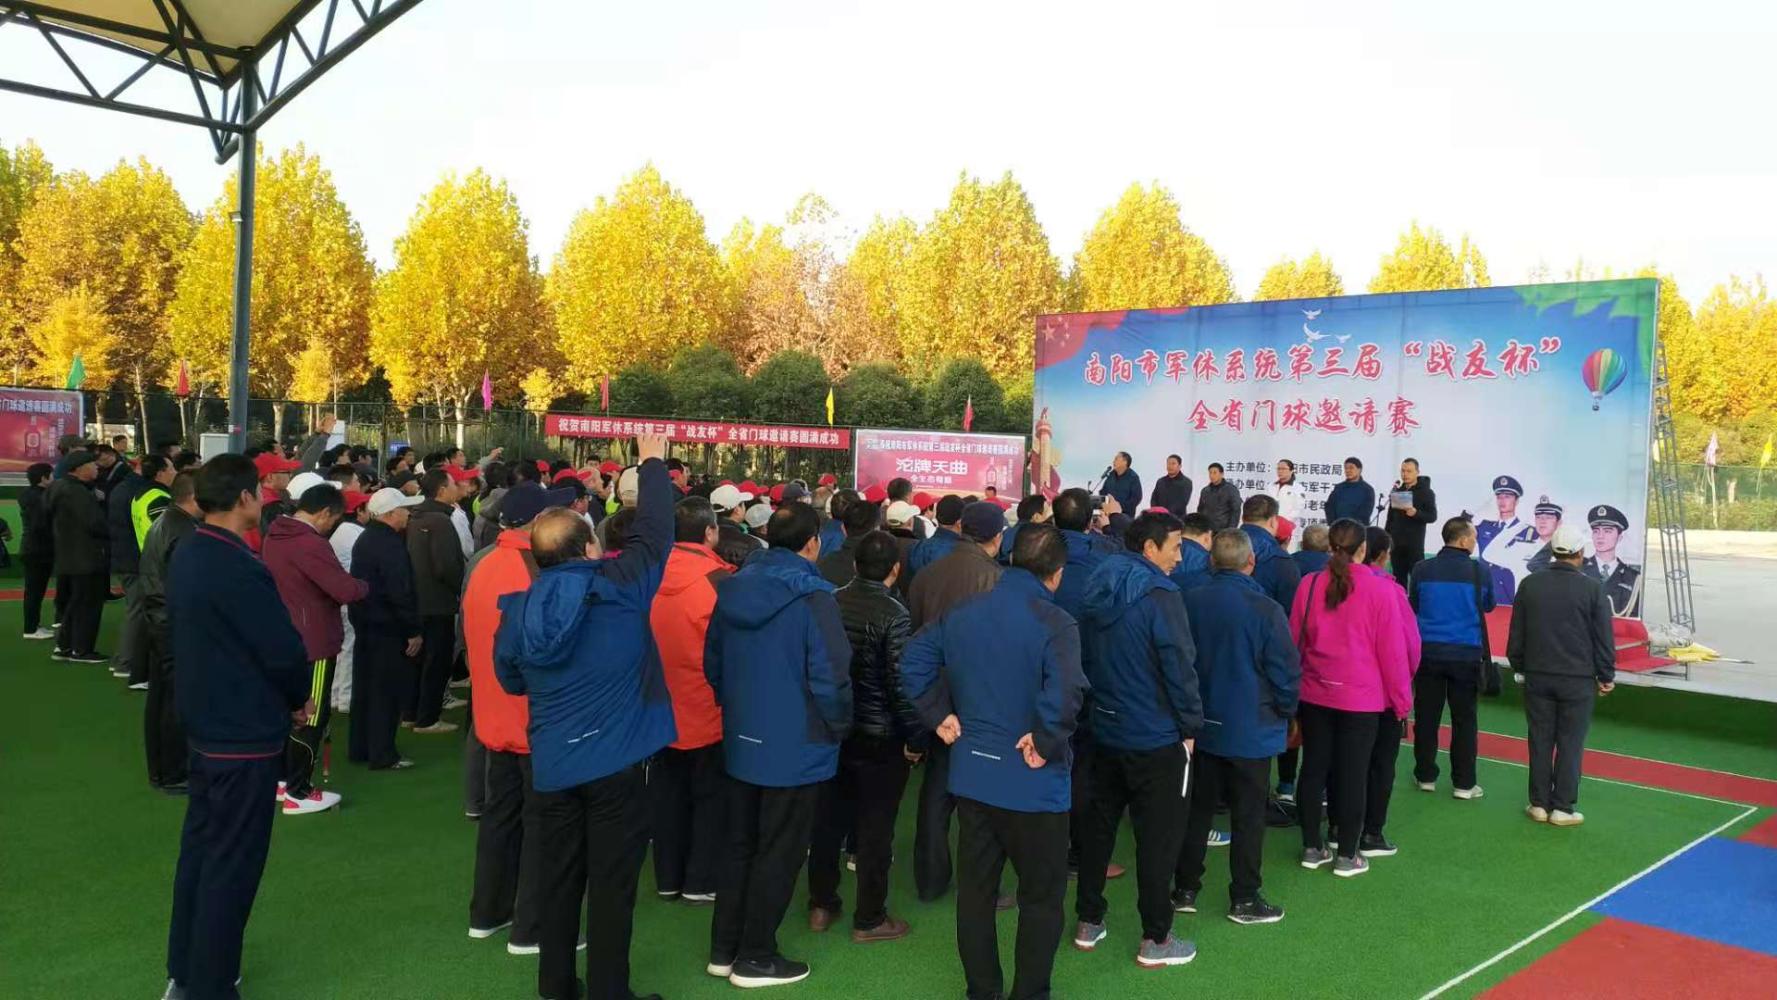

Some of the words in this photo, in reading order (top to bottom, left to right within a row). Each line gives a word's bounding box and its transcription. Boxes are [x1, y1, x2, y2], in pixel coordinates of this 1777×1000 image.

[1084, 336, 1560, 385] 南阳市军休系统第三届“战友杯”
[1186, 398, 1420, 435] 全省门球邀请赛
[895, 456, 968, 475] 沱牌天曲
